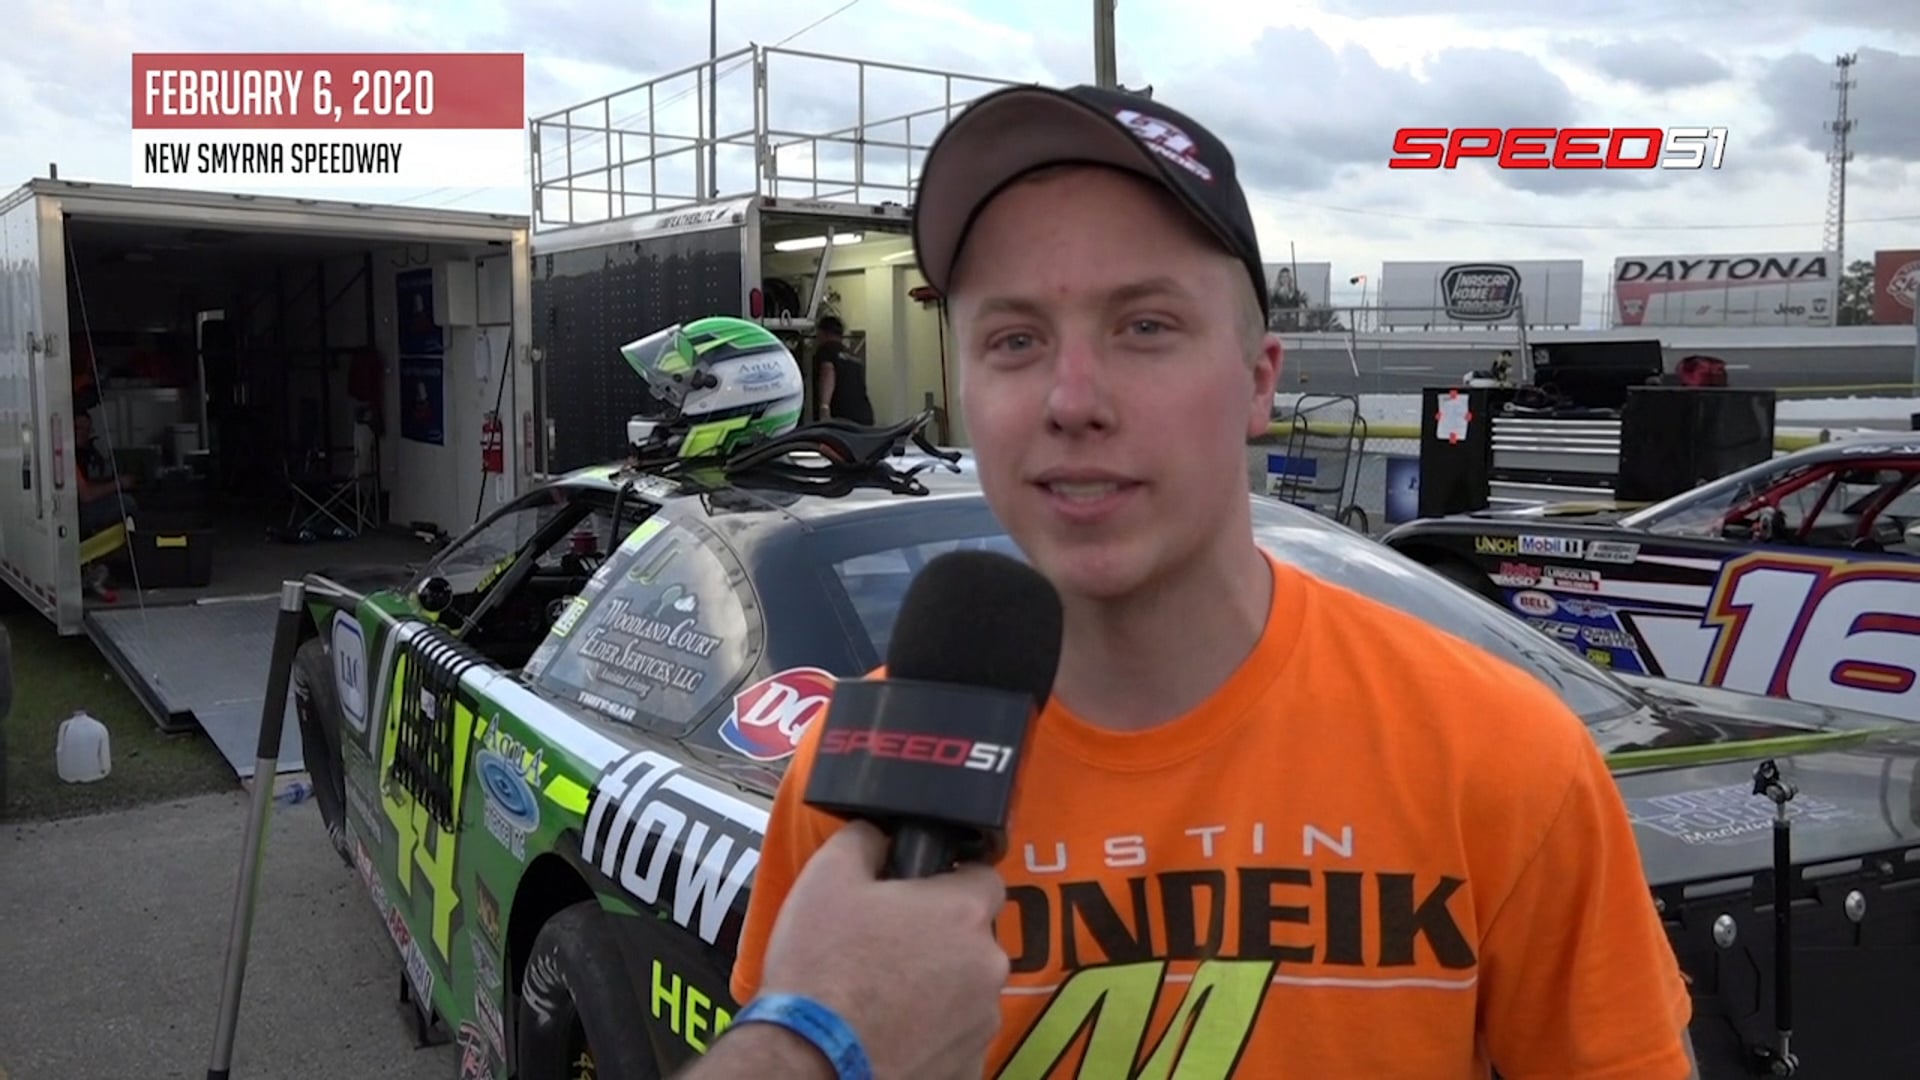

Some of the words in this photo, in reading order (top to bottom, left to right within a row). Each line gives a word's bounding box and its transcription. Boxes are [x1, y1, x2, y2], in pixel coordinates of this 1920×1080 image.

[1617, 257, 1827, 281] DAYTONA
[1774, 302, 1805, 316] Jeep
[1475, 536, 1518, 552] UNOH
[1523, 537, 1561, 551] Mobil
[1520, 597, 1550, 608] BELL
[603, 599, 671, 643] WOODLAND
[667, 618, 720, 656] COURT
[579, 628, 620, 665] ELDER
[672, 665, 703, 691] LLC
[821, 729, 1012, 773] SPEED51
[580, 750, 758, 946] flow
[1024, 822, 1354, 873] USTIN
[994, 867, 1478, 974] ONDEIK
